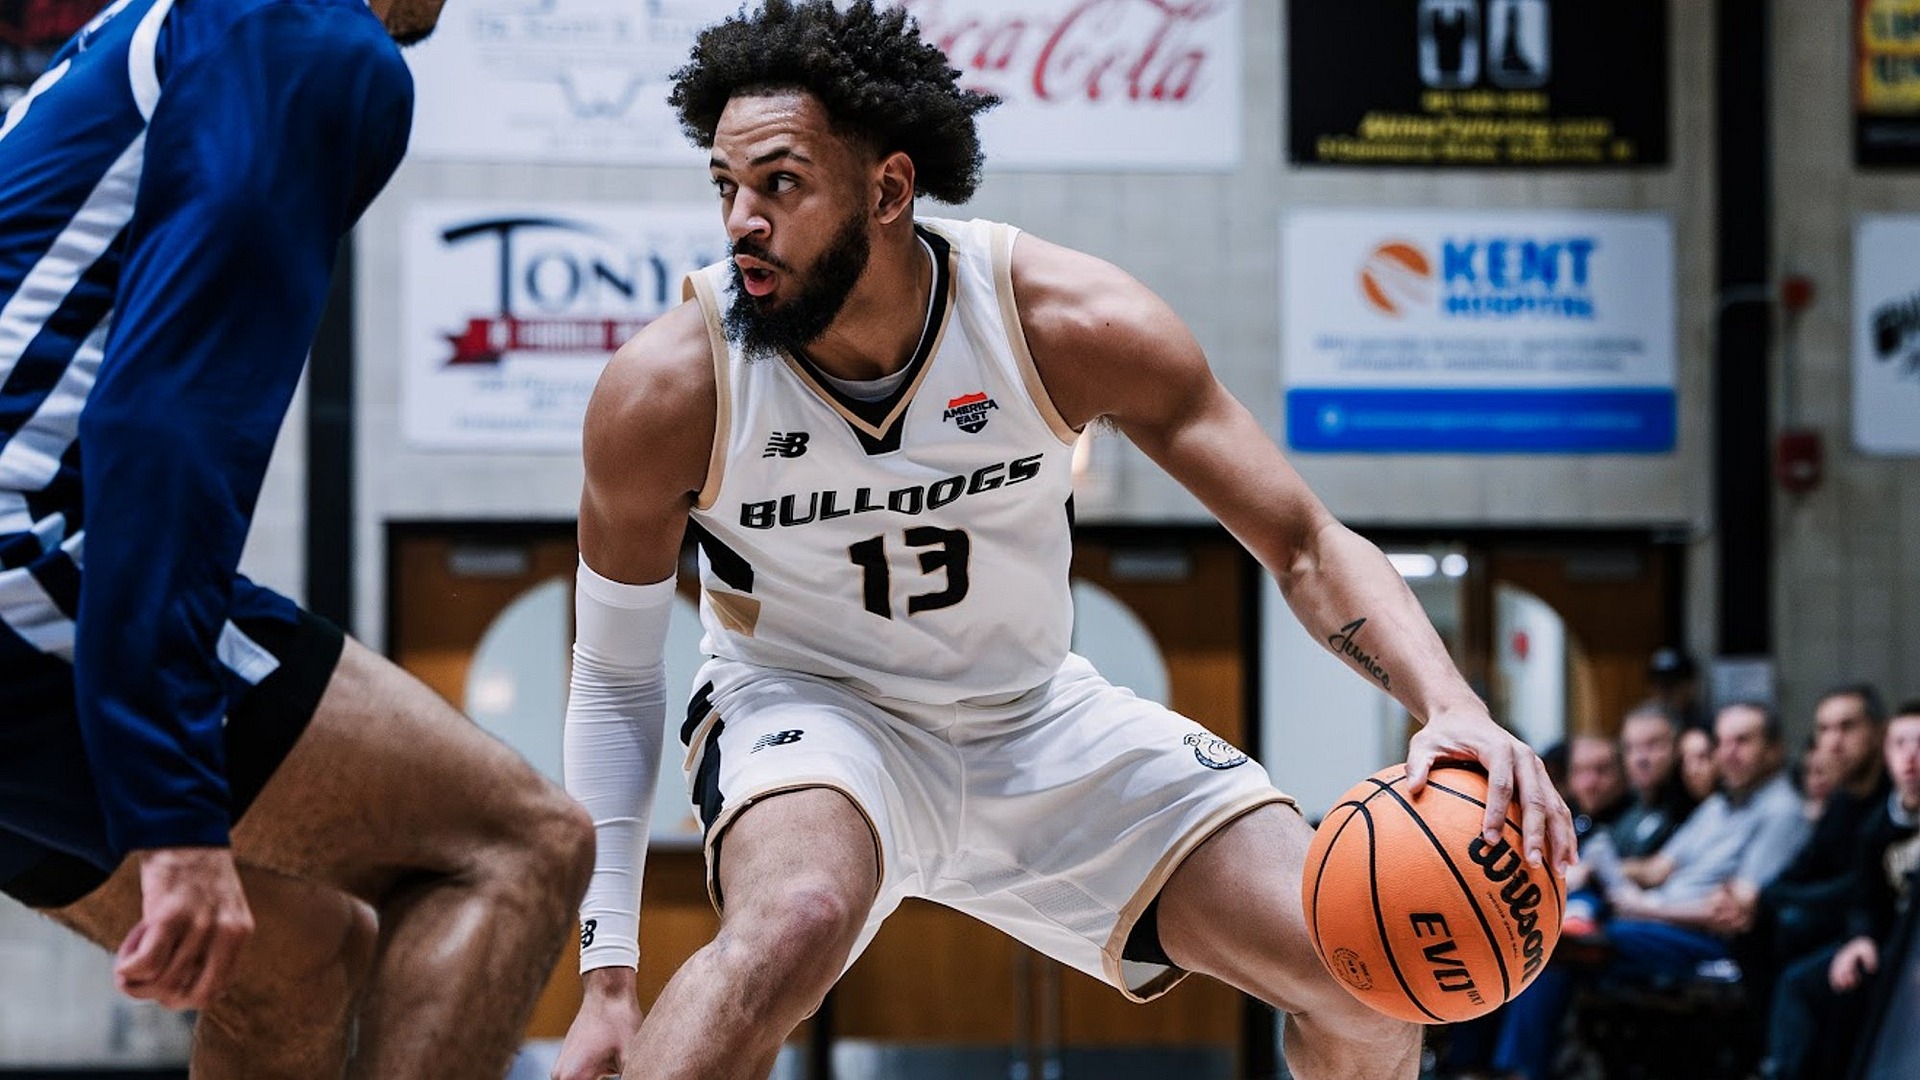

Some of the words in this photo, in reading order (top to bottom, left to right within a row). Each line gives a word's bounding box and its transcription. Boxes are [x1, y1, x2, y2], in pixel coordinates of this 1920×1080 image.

[1442, 236, 1597, 290] KENT
[943, 398, 999, 422] AMERICA
[955, 410, 987, 425] EAST
[740, 453, 1044, 530] BULLDOGS
[848, 525, 972, 621] 13
[1469, 832, 1544, 984] Wilson
[1409, 912, 1475, 992] EVO
